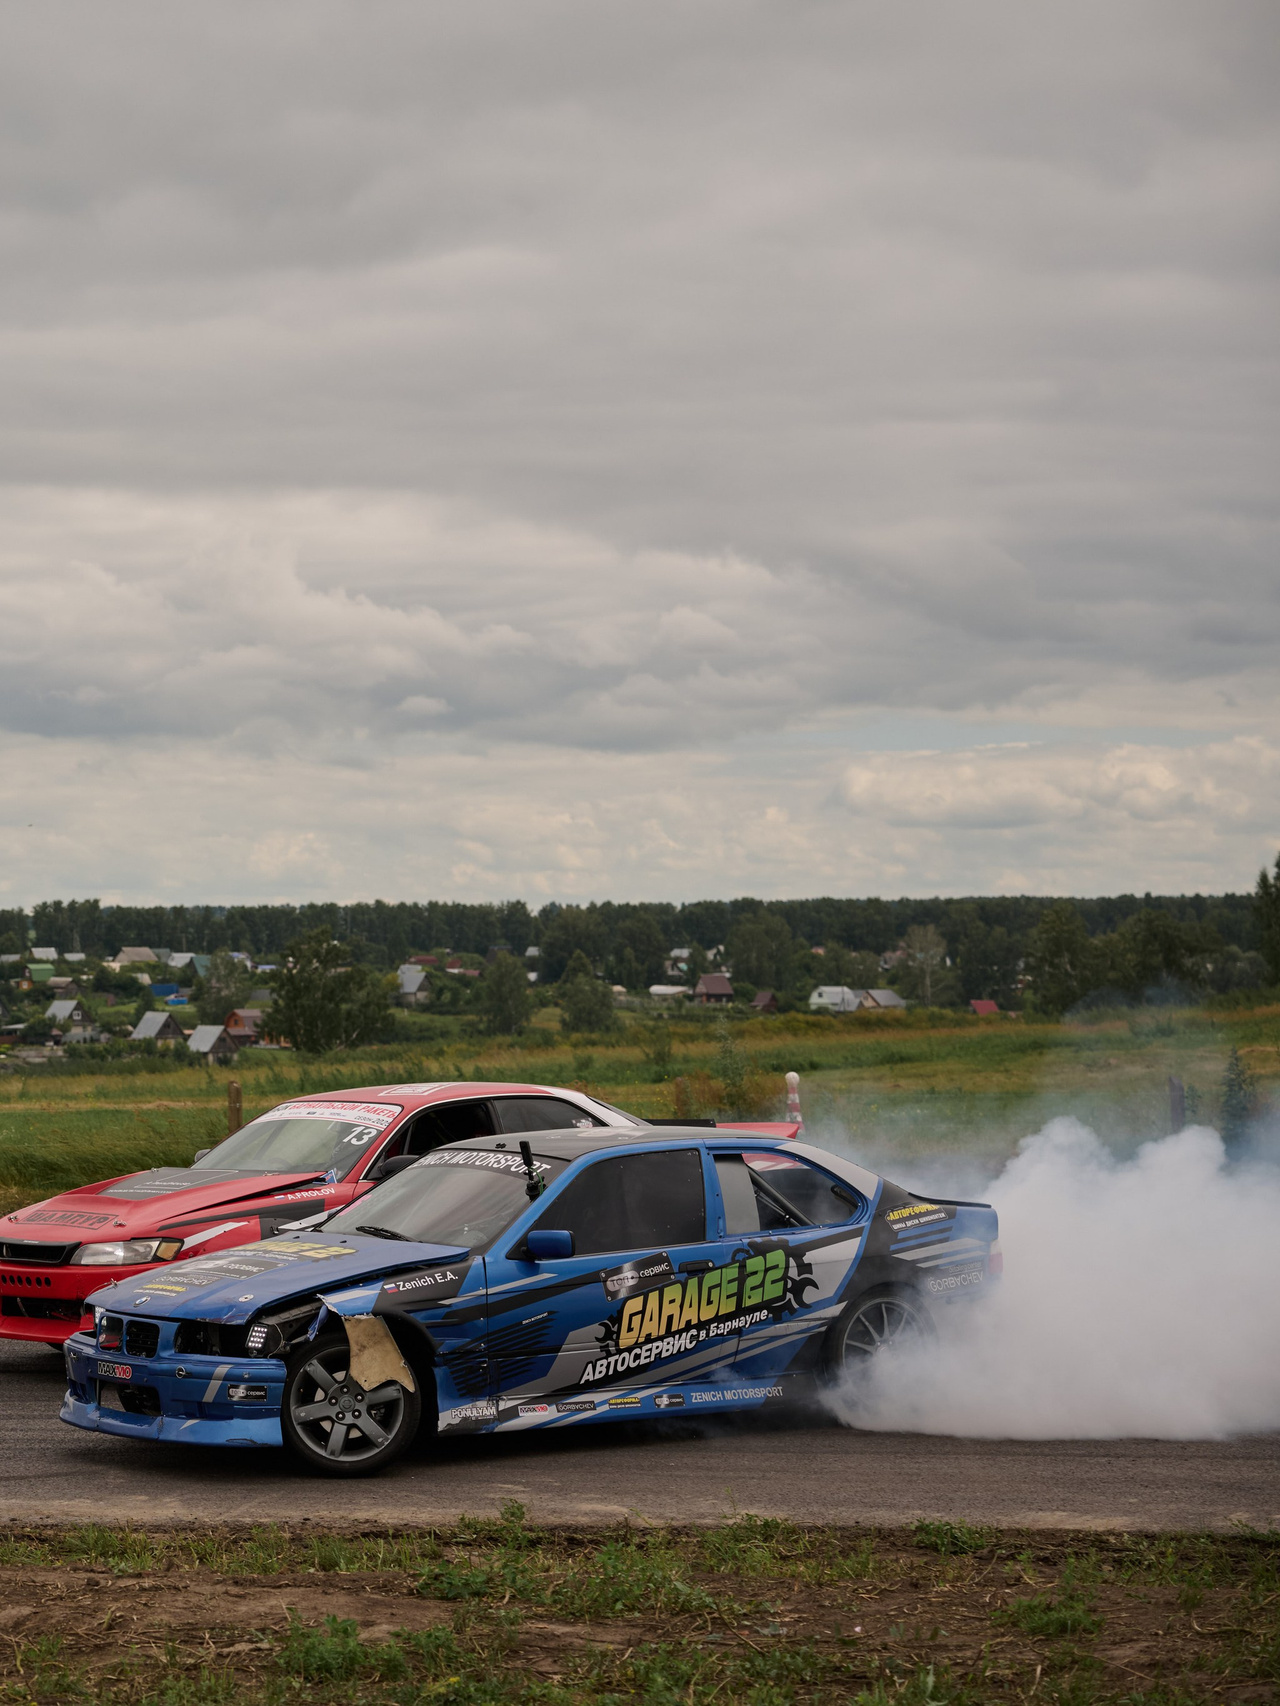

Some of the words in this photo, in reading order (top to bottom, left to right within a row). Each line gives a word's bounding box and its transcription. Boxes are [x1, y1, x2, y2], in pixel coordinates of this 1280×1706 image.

[343, 1126, 377, 1145] 13
[287, 1187, 336, 1201] A.FROLOV
[25, 1212, 110, 1226] ШАМПУР
[639, 1262, 670, 1278] сервис
[396, 1275, 435, 1291] Zenich
[434, 1271, 459, 1283] E.A.
[619, 1263, 741, 1348] GARAGE
[742, 1249, 786, 1307] 22
[579, 1329, 698, 1384] АВТОСЕРВИС
[699, 1330, 706, 1341] в
[709, 1309, 768, 1336] Барнауле
[98, 1361, 132, 1380] MAXMO
[690, 1390, 721, 1403] ZENICH
[724, 1386, 783, 1401] MOTORSPORT
[451, 1406, 496, 1419] PONULYAM
